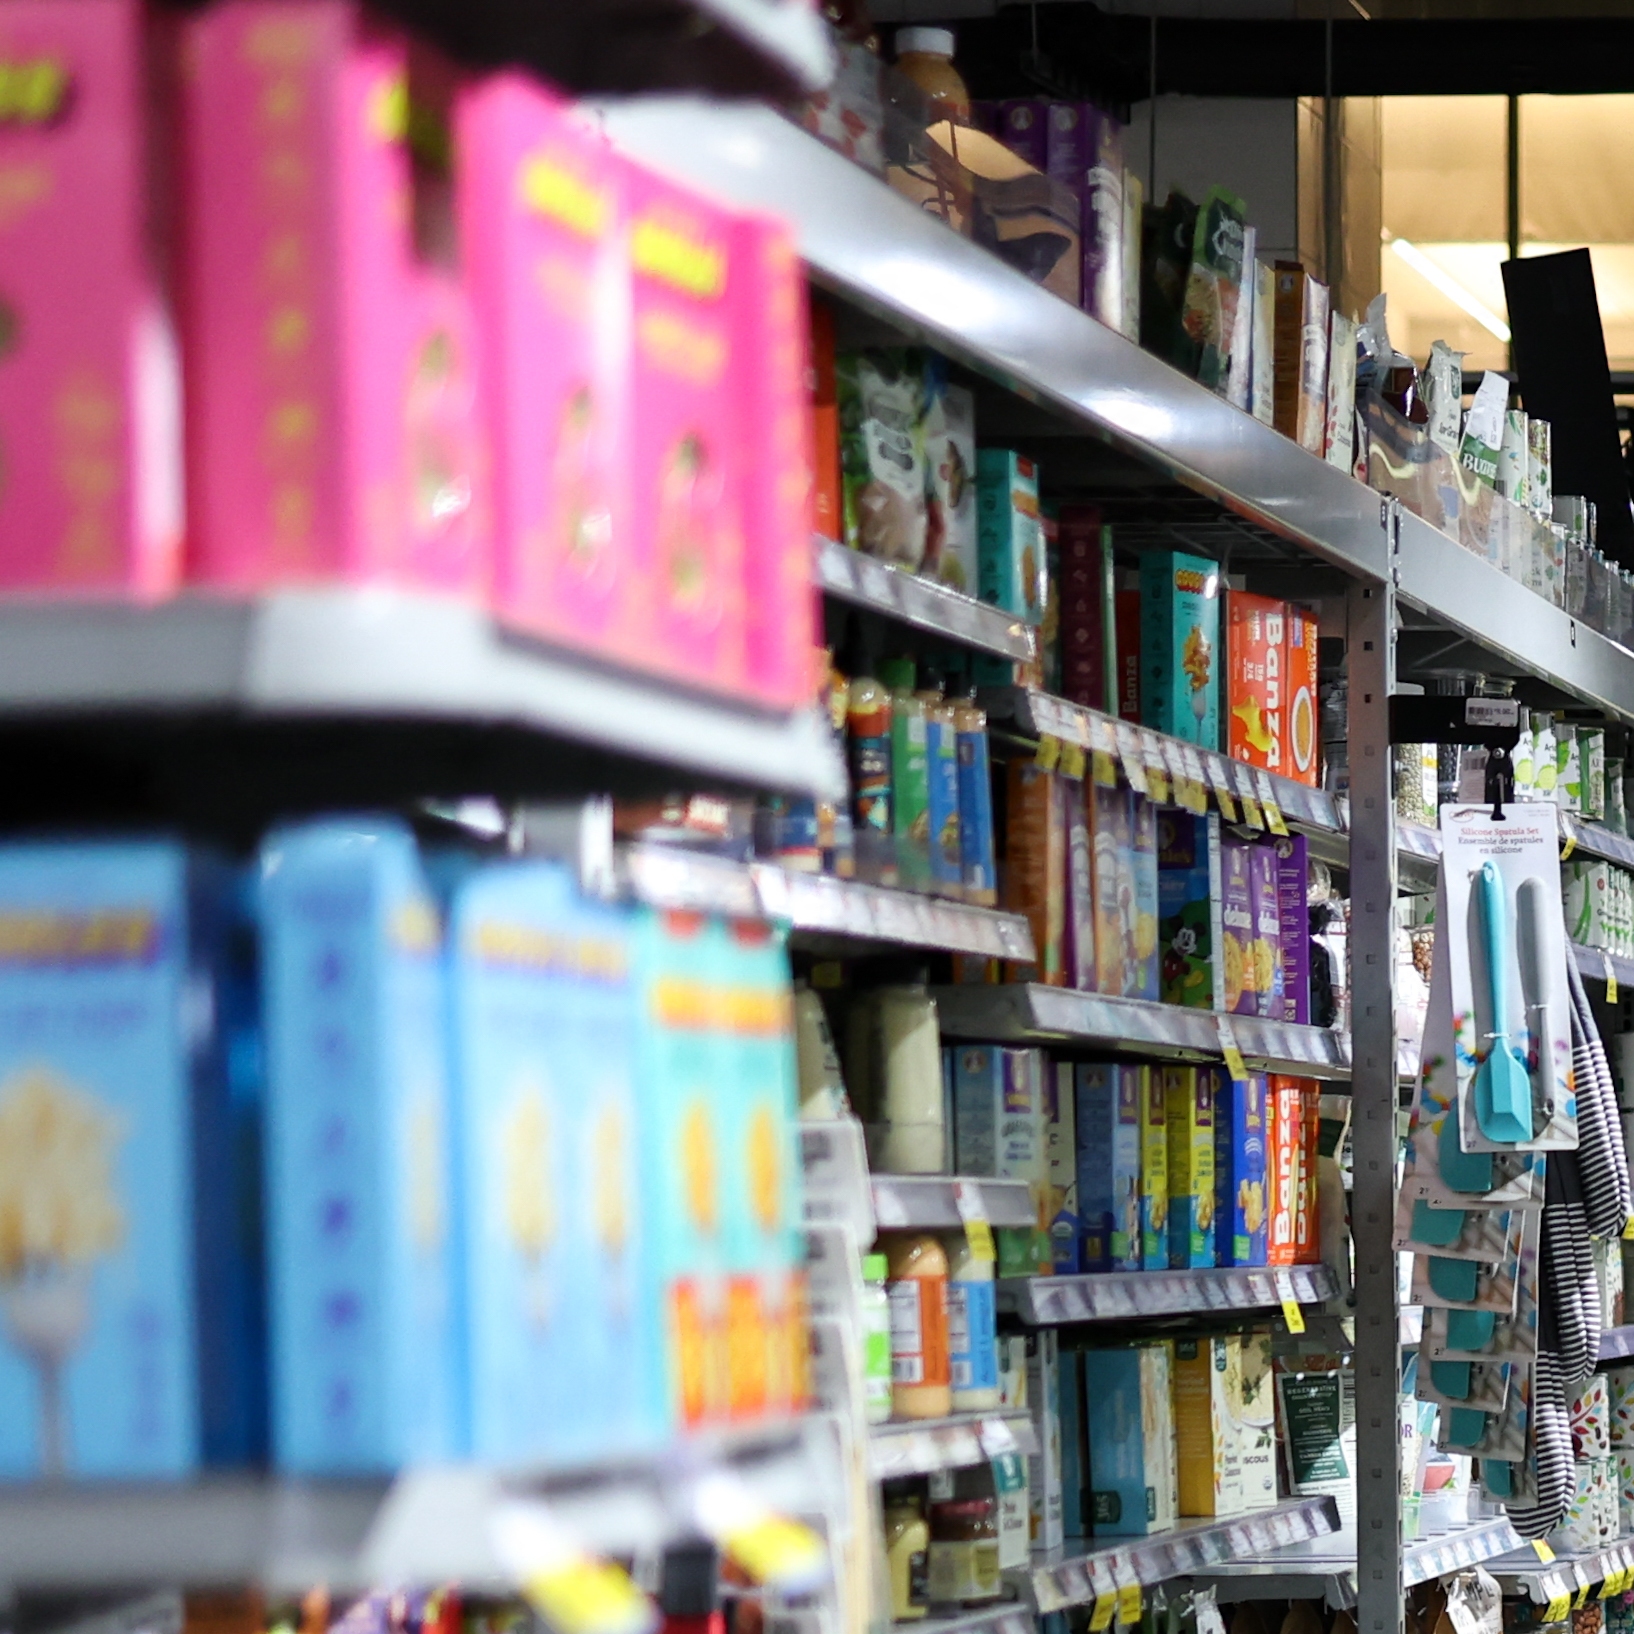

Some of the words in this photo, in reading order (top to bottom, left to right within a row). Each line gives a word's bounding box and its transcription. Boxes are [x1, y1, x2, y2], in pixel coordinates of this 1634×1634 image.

[1265, 612, 1284, 769] Banza
[1460, 827, 1493, 836] Silicone
[1494, 827, 1526, 837] Spatula
[1526, 827, 1539, 835] Set
[1458, 836, 1498, 846] Ensemble
[1498, 836, 1509, 845] de
[1509, 836, 1544, 847] spatules
[1491, 845, 1523, 854] silicone
[1275, 1088, 1291, 1245] Banza
